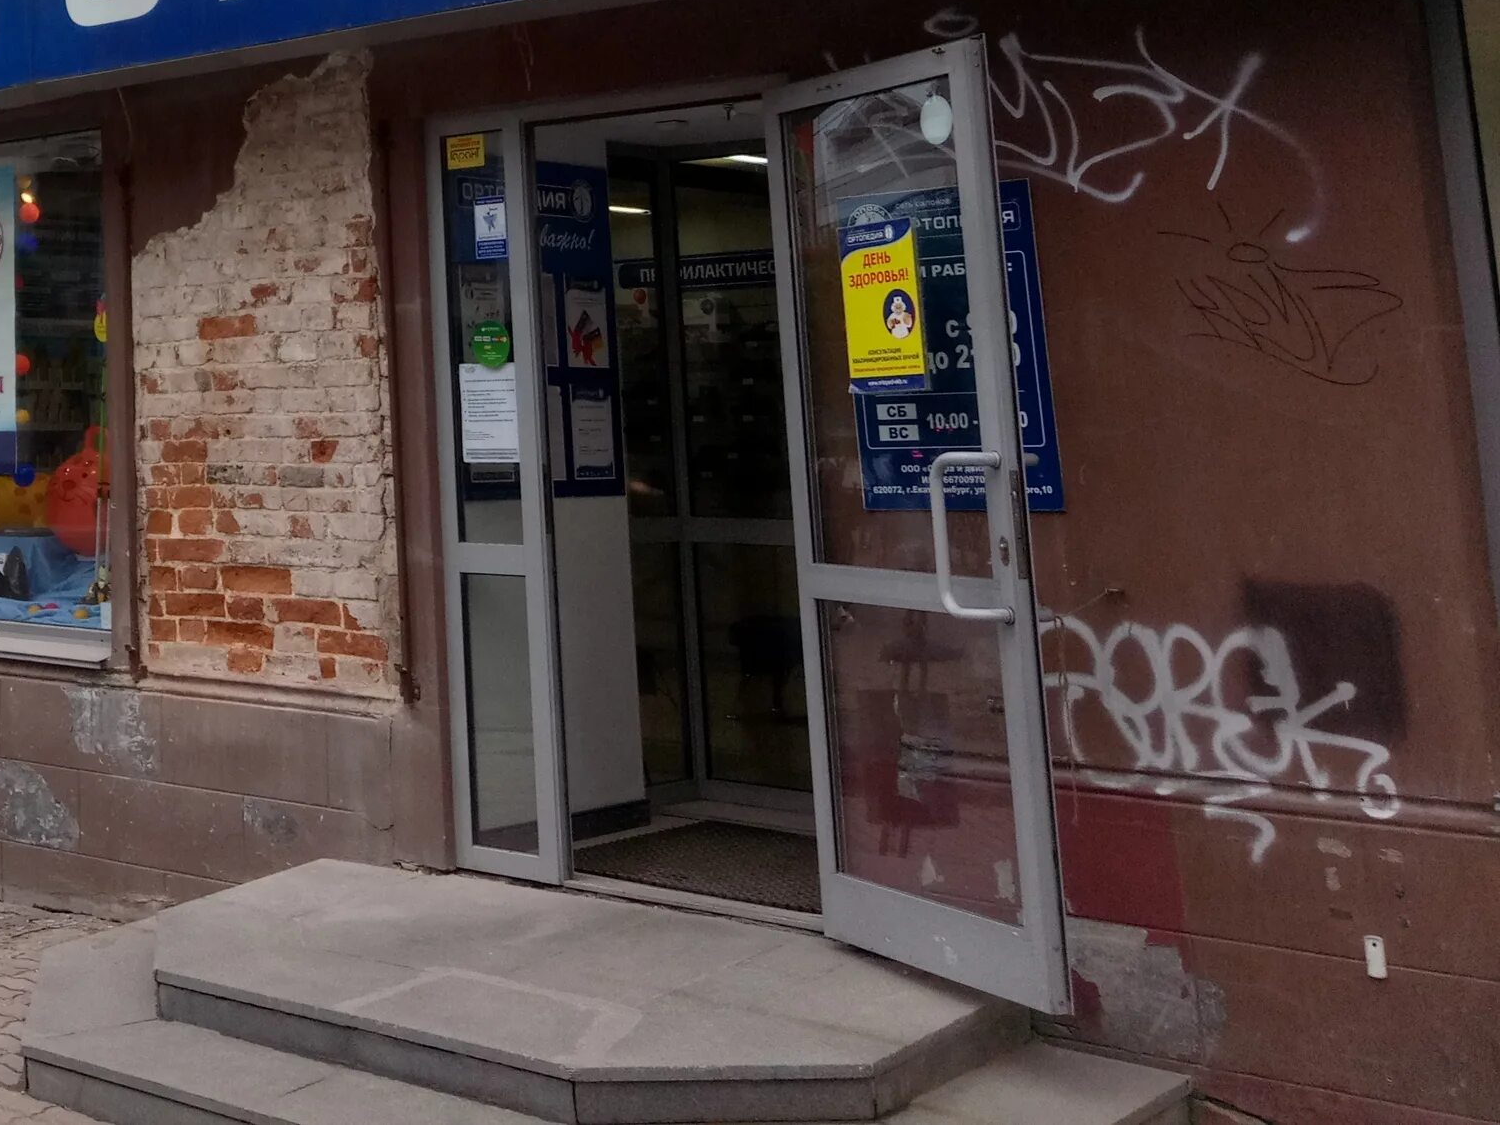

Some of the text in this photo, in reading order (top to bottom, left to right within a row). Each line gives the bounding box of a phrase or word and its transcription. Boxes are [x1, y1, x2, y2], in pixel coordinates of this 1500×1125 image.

[863, 251, 891, 267] ДЕНЬ
[849, 268, 910, 289] ЗДОРОВЬЯ!
[887, 405, 907, 418] СБ
[888, 427, 909, 439] ВС
